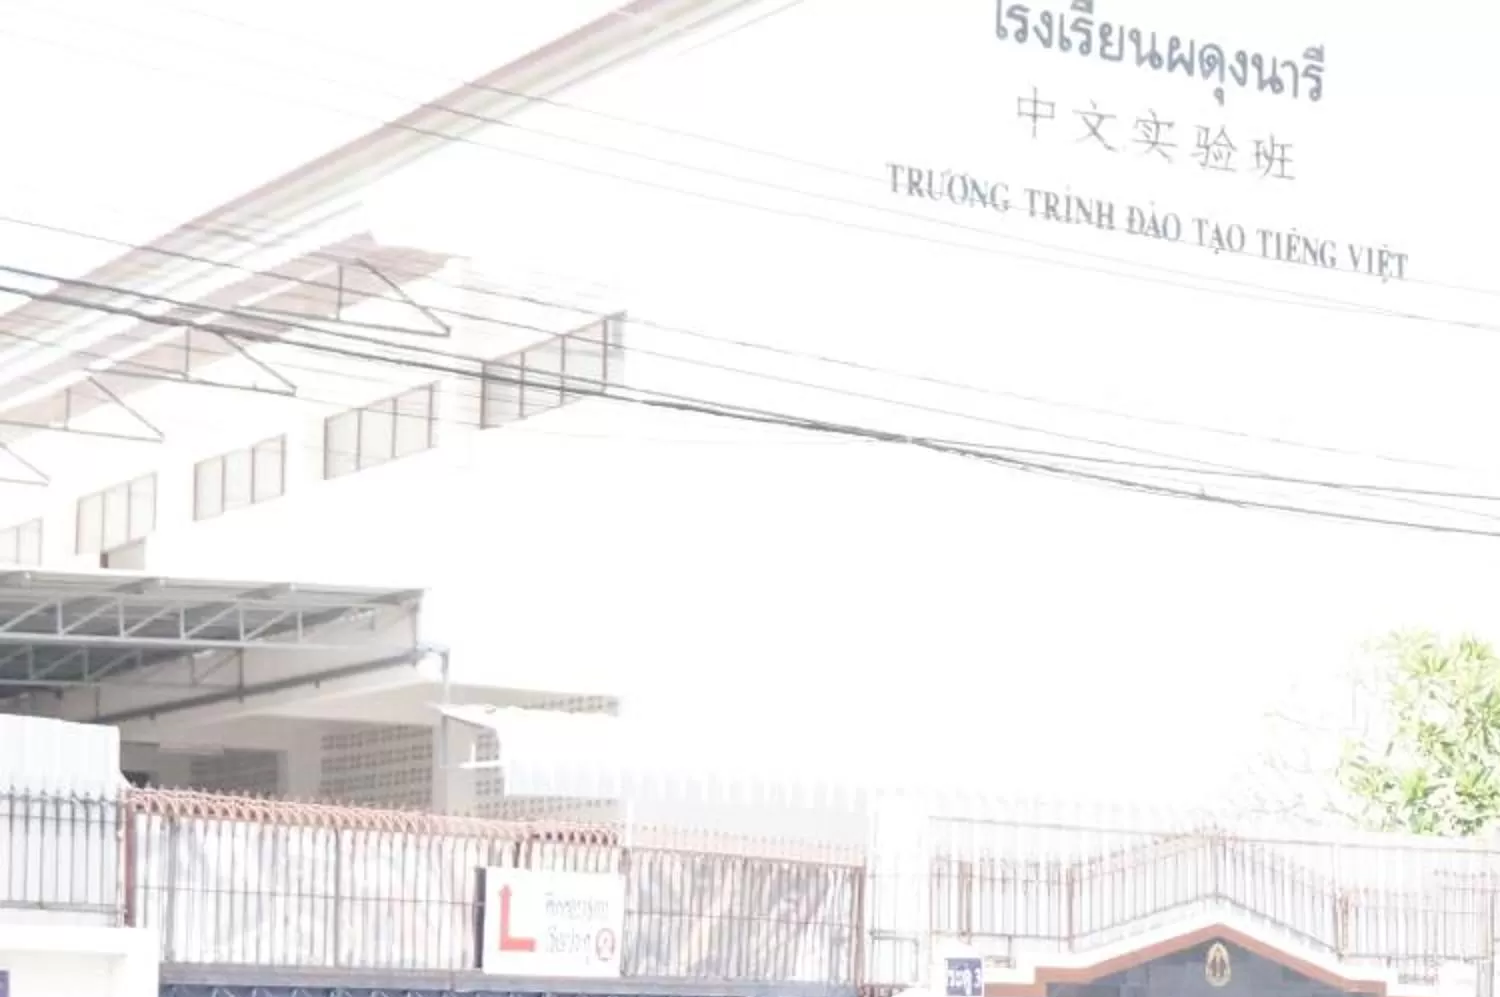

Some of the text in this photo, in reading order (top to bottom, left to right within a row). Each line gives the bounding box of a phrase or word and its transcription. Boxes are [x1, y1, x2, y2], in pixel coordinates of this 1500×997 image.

[1016, 83, 1297, 181] 中文实验班
[1191, 216, 1247, 256] TẠO
[1347, 243, 1409, 284] VIỆT
